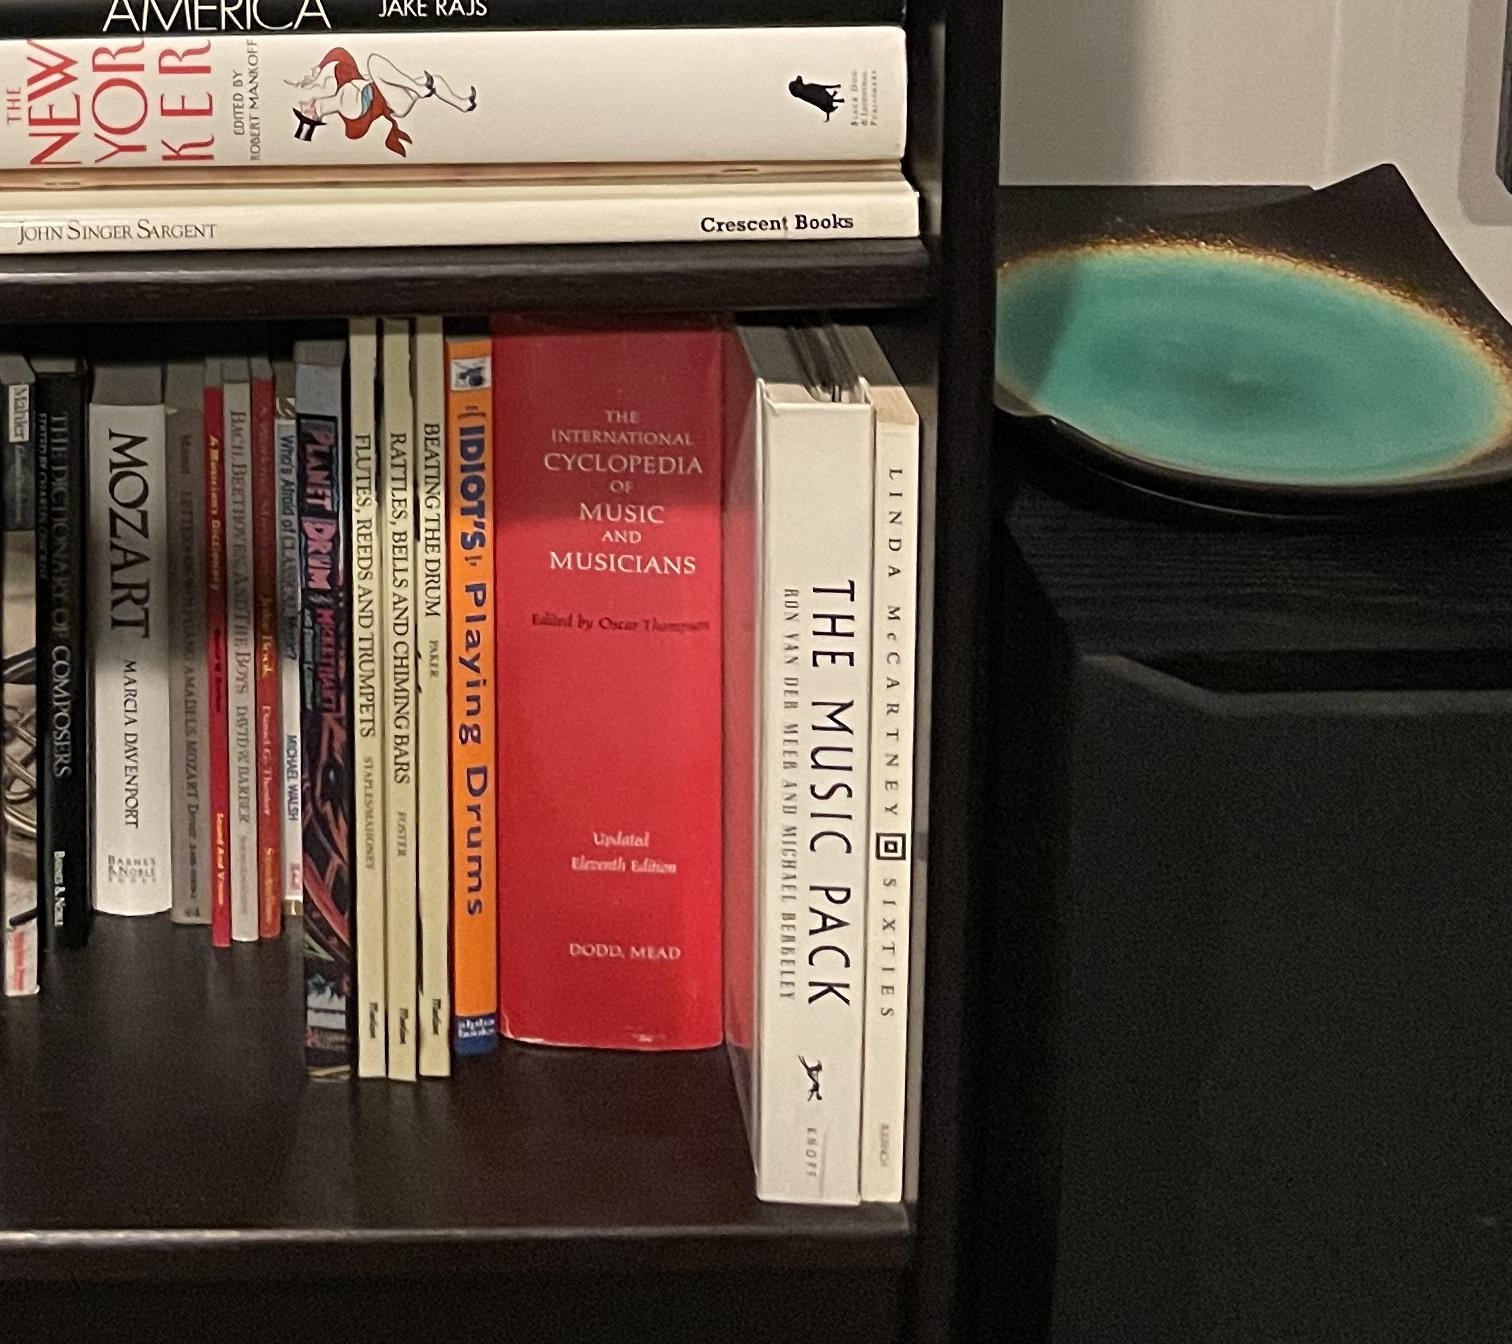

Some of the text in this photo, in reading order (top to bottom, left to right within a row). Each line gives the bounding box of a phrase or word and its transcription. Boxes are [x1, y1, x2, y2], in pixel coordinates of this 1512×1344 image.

[7, 85, 23, 124] THE
[26, 39, 83, 167] NEW
[17, 220, 218, 246] JOHN SINGER SARGENT
[605, 410, 639, 424] THE
[552, 430, 694, 446] INTERNATIONAL
[544, 453, 703, 475] CYCLOPEDIA
[609, 480, 634, 494] OF
[423, 422, 442, 618] BEATING THE DRUM
[579, 503, 665, 524] MUSIC
[107, 428, 150, 639] MOZART
[601, 530, 642, 544] AND
[549, 552, 696, 576] MUSICIANS
[123, 659, 139, 828] MARCIA DAVENPORT
[879, 467, 903, 1018] LINDA McCARTNEY SIXTIES
[808, 579, 855, 1007] THE MUSIC PACK
